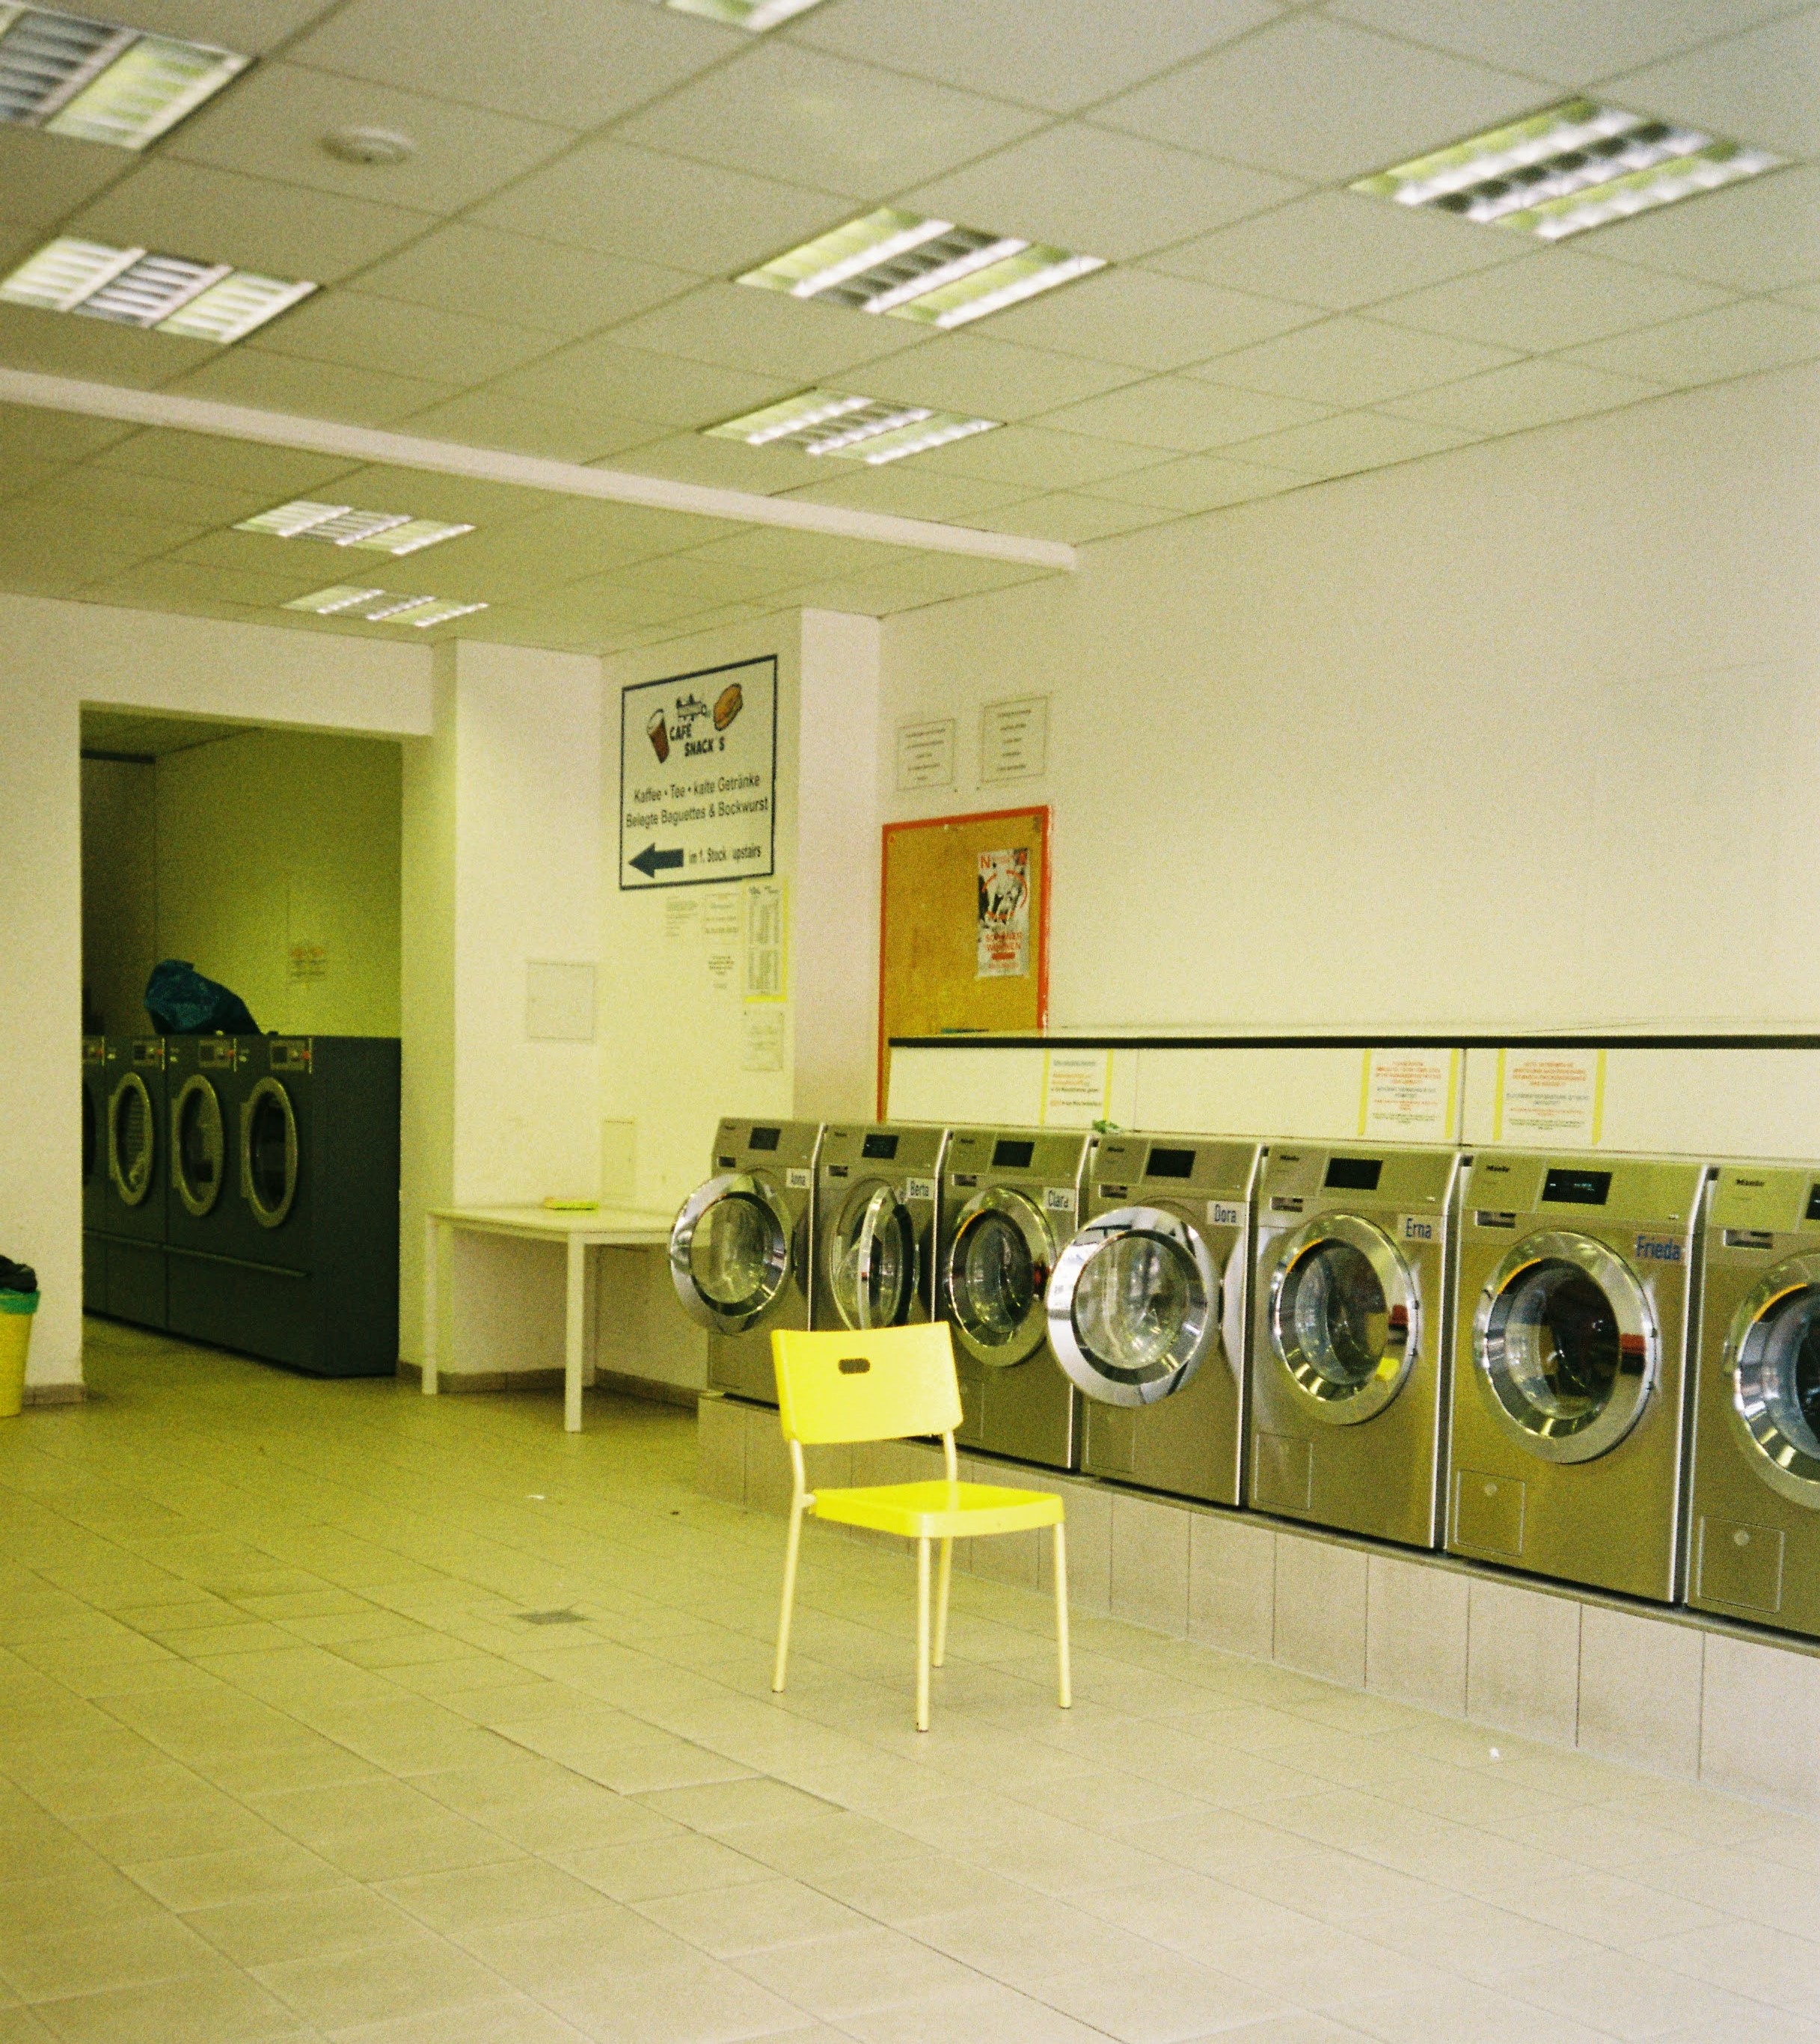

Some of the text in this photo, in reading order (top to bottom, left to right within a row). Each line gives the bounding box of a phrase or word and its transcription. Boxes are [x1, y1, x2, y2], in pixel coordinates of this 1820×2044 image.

[634, 773, 761, 803] Kaffee Tee kalte Getränke
[626, 797, 768, 829] Belegte Baguettes & Bockwurst
[732, 843, 762, 863] upstairs
[910, 1180, 929, 1197] Berta
[1048, 1190, 1069, 1208] Clara
[1214, 1203, 1237, 1223] Dora
[1406, 1218, 1432, 1239] Erna
[1637, 1235, 1681, 1260] Frieda
